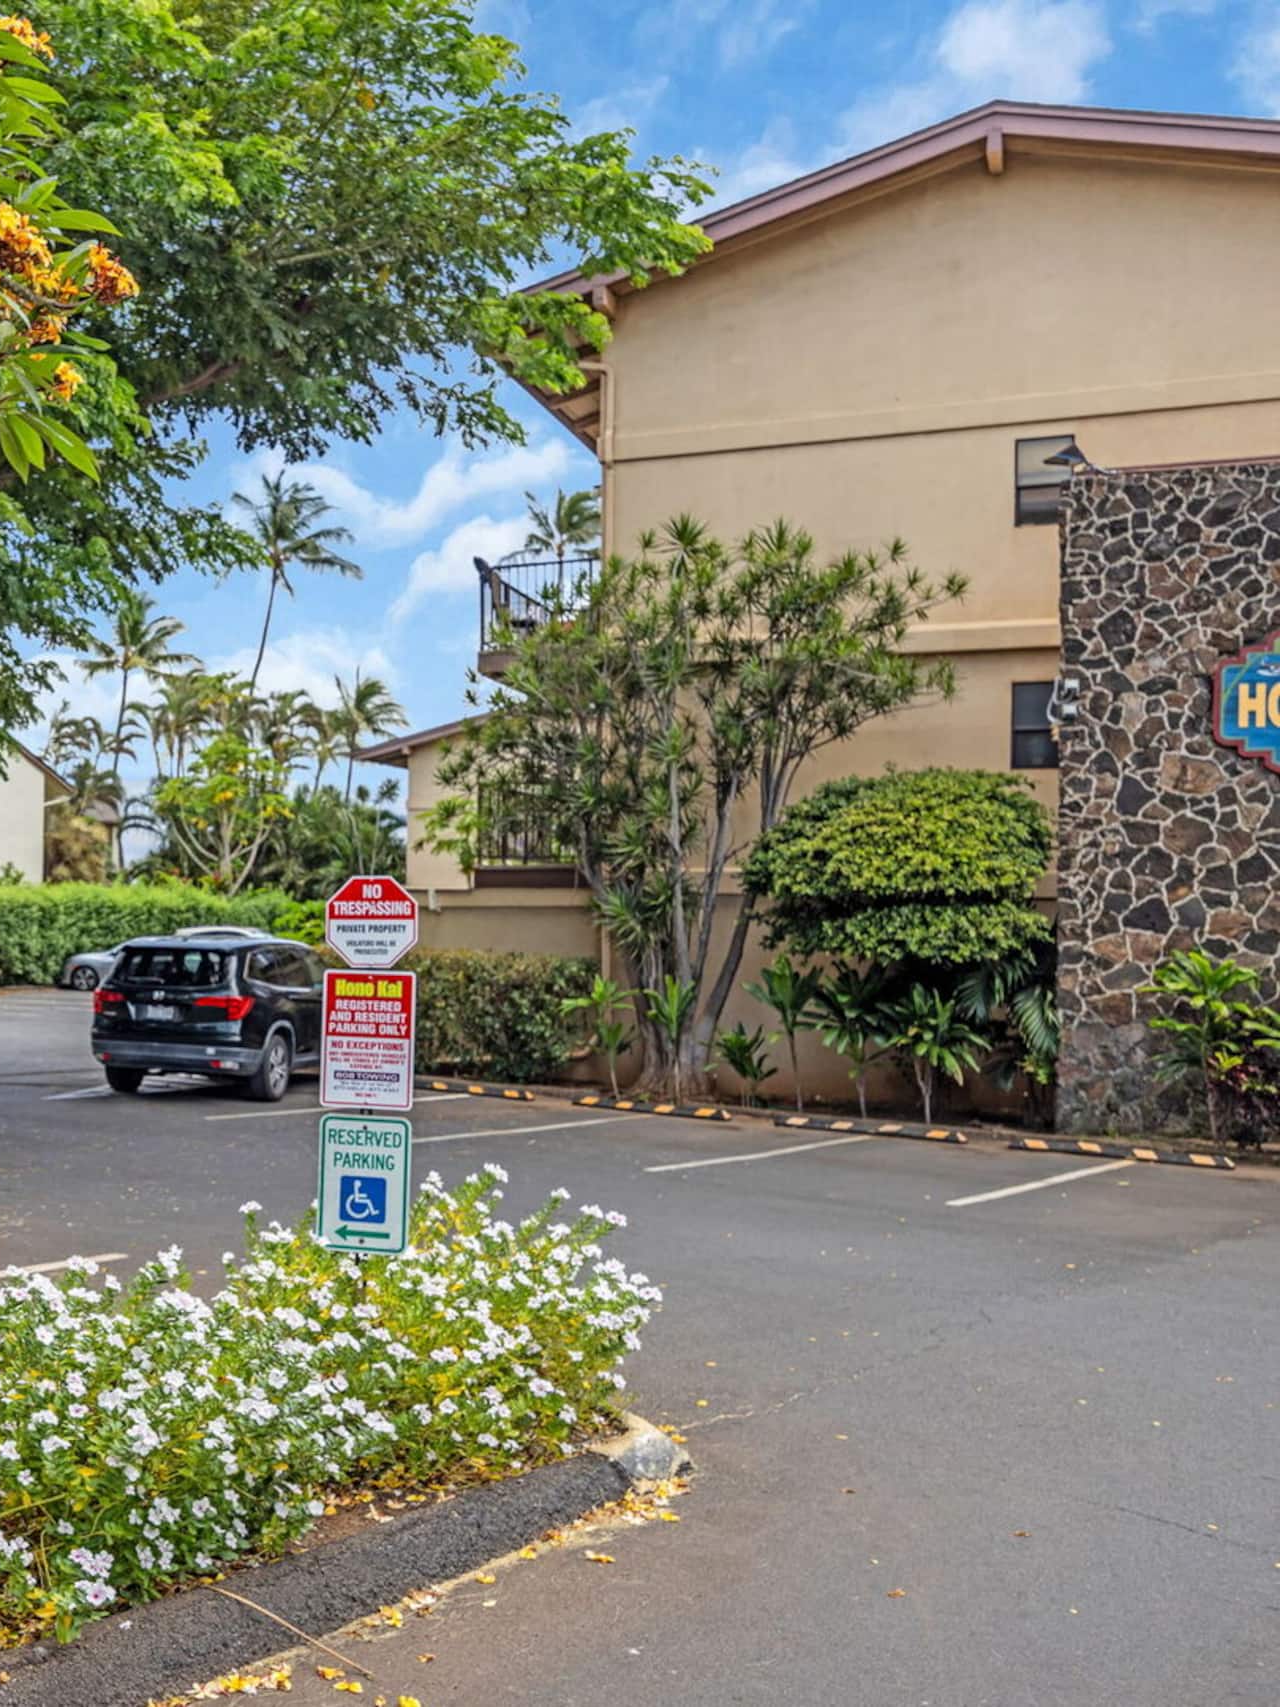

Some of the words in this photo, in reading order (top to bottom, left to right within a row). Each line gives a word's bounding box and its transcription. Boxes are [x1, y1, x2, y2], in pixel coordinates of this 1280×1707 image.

[362, 884, 382, 899] NO
[333, 901, 412, 916] TRESPASSING
[336, 924, 365, 933] PRIVATE
[368, 924, 406, 933] PROPERTY
[335, 979, 375, 997] Hono
[377, 980, 403, 998] Kai
[335, 1000, 402, 1012] REGISTERED
[330, 1011, 352, 1022] AND
[354, 1012, 407, 1024] RESIDENT
[328, 1023, 376, 1034] PARKING
[378, 1024, 408, 1036] ONLY
[331, 1040, 344, 1049] NO
[346, 1041, 404, 1051] EXCEPTIONS
[328, 1128, 402, 1148] RESERVED
[333, 1151, 395, 1171] PARKING
